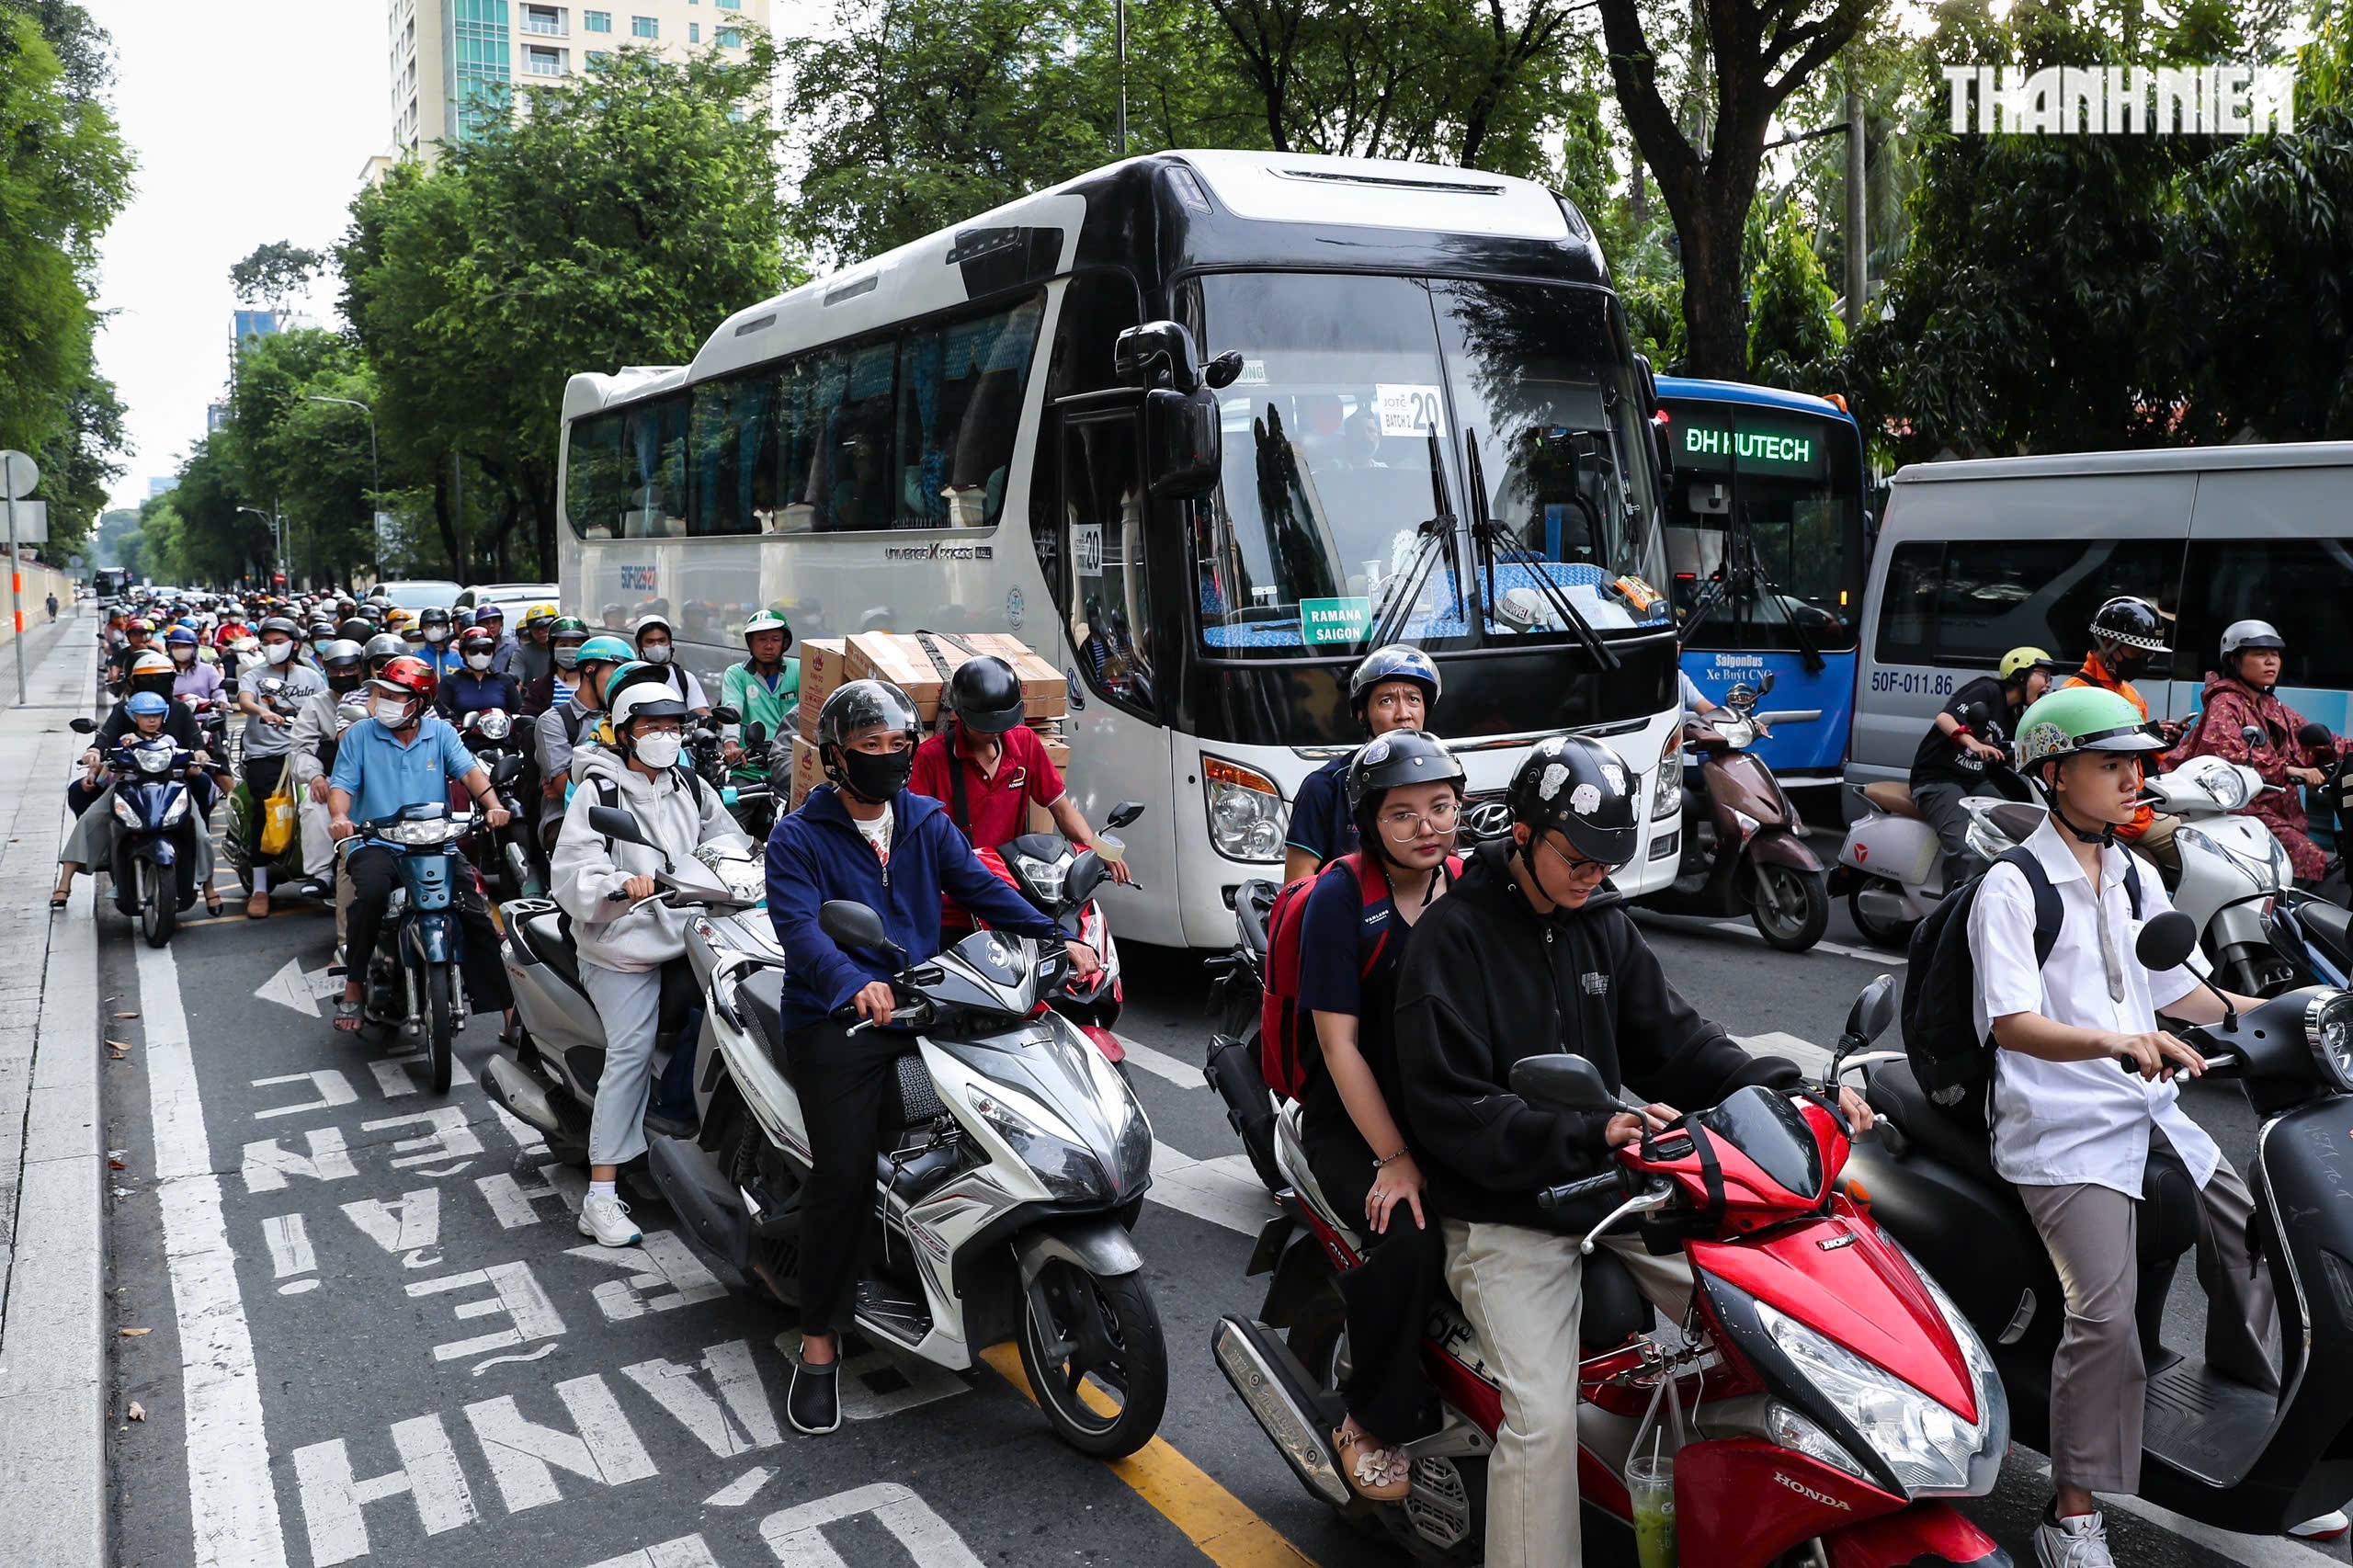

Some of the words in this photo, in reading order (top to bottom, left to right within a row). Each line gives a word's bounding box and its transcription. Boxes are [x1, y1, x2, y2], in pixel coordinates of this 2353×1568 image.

[1411, 392, 1439, 430] 20
[1385, 414, 1406, 428] BATCH
[1086, 530, 1100, 570] 20
[1311, 609, 1362, 622] RAMANA
[1503, 597, 1528, 619] MARVEL
[1316, 628, 1361, 641] SAIGON
[1715, 653, 1763, 668] SaigonBus
[1706, 669, 1721, 681] Xe
[1723, 668, 1746, 683] Buýt
[1871, 672, 1952, 697] 50F-011.86
[1365, 909, 1390, 923] VANLANG
[1773, 1471, 1852, 1511] HONDA
